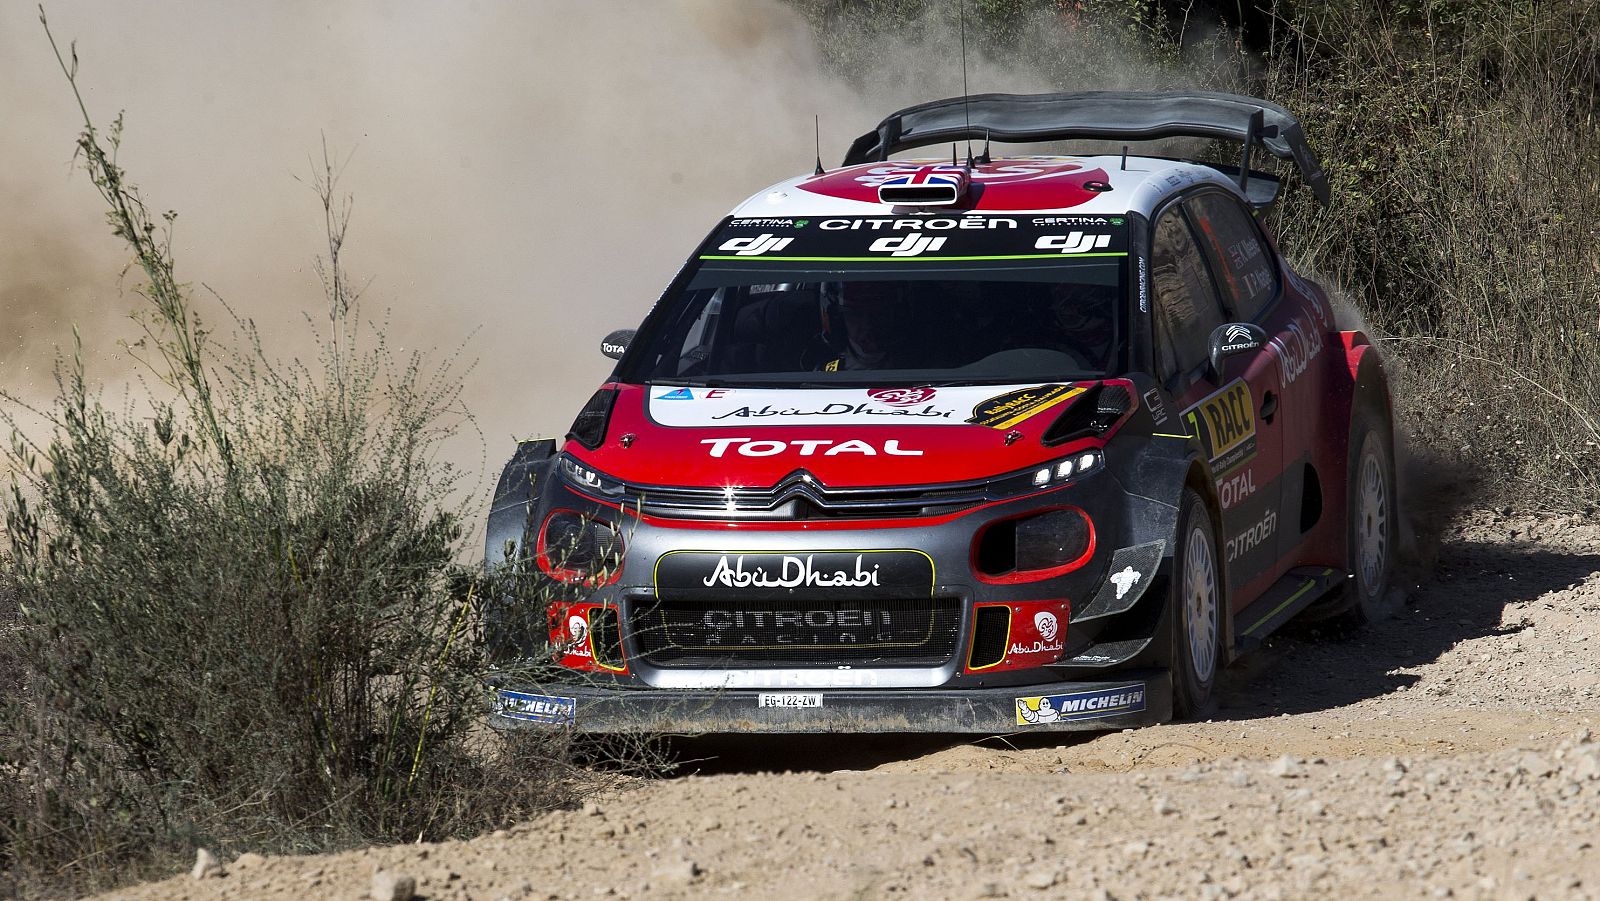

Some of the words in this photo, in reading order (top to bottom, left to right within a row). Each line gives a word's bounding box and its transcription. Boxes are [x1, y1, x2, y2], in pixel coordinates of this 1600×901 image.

[818, 215, 1018, 230] CITROËN
[603, 342, 626, 354] TOTA
[1206, 385, 1250, 449] RACC
[700, 437, 924, 458] TOTAL
[1216, 468, 1256, 509] TOTAL
[1226, 509, 1277, 562] CITROËN
[764, 695, 816, 706] EG-122-ZW
[1061, 689, 1144, 713] MICHELIN
